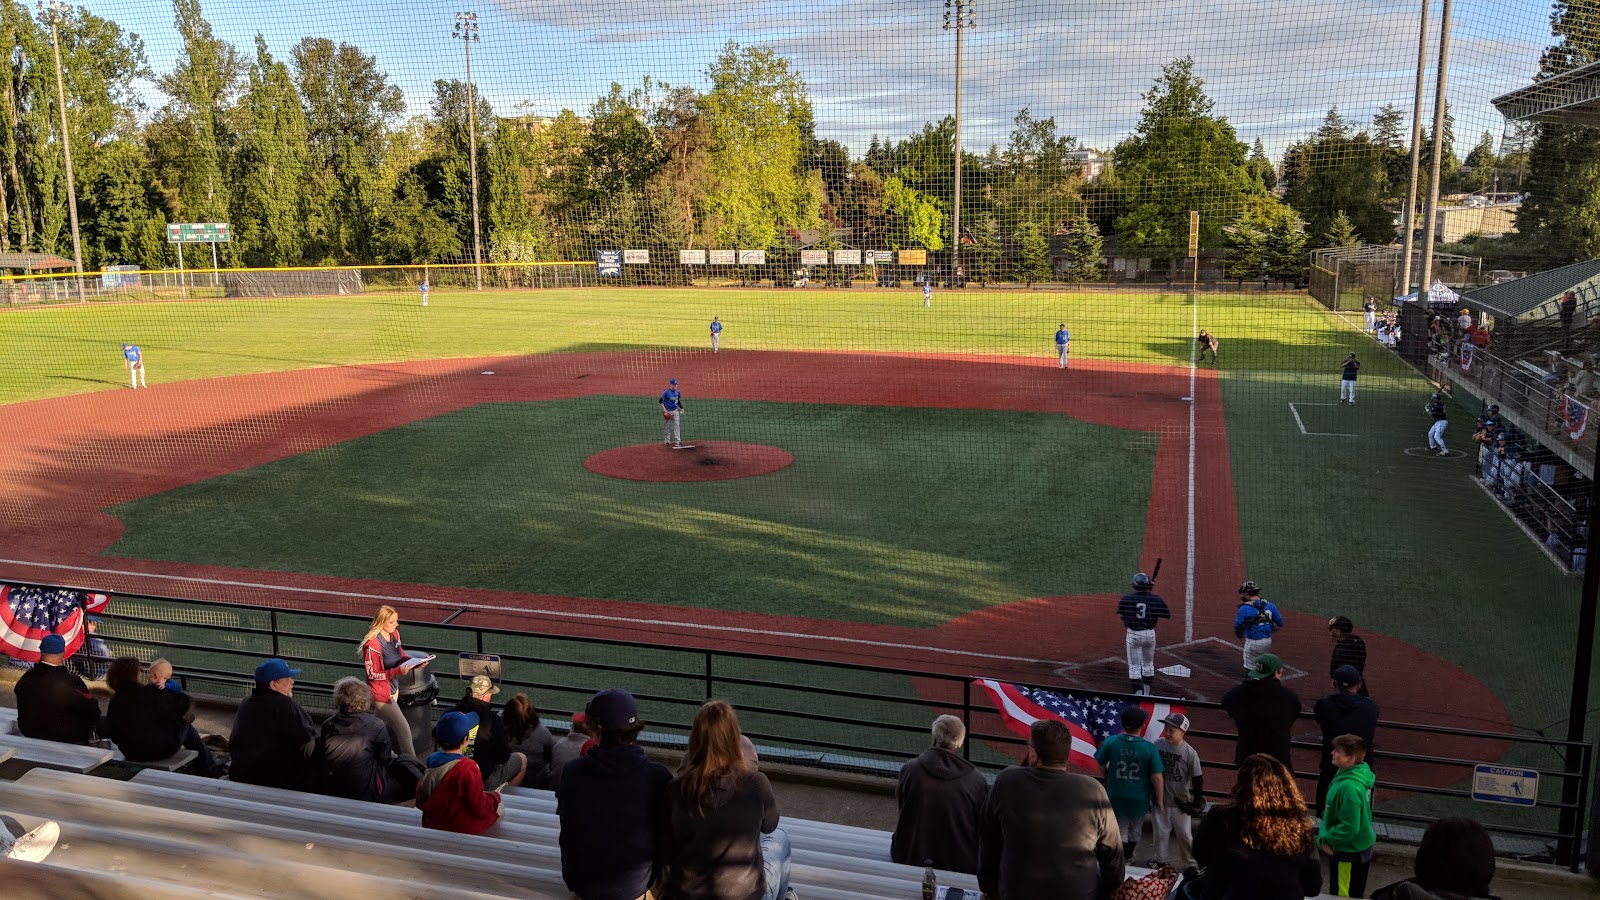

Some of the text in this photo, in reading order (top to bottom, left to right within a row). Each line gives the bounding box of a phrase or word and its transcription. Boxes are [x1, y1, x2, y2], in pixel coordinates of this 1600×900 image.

[1136, 602, 1147, 619] 3
[1117, 761, 1141, 780] 22
[1490, 767, 1524, 777] CAUTION
